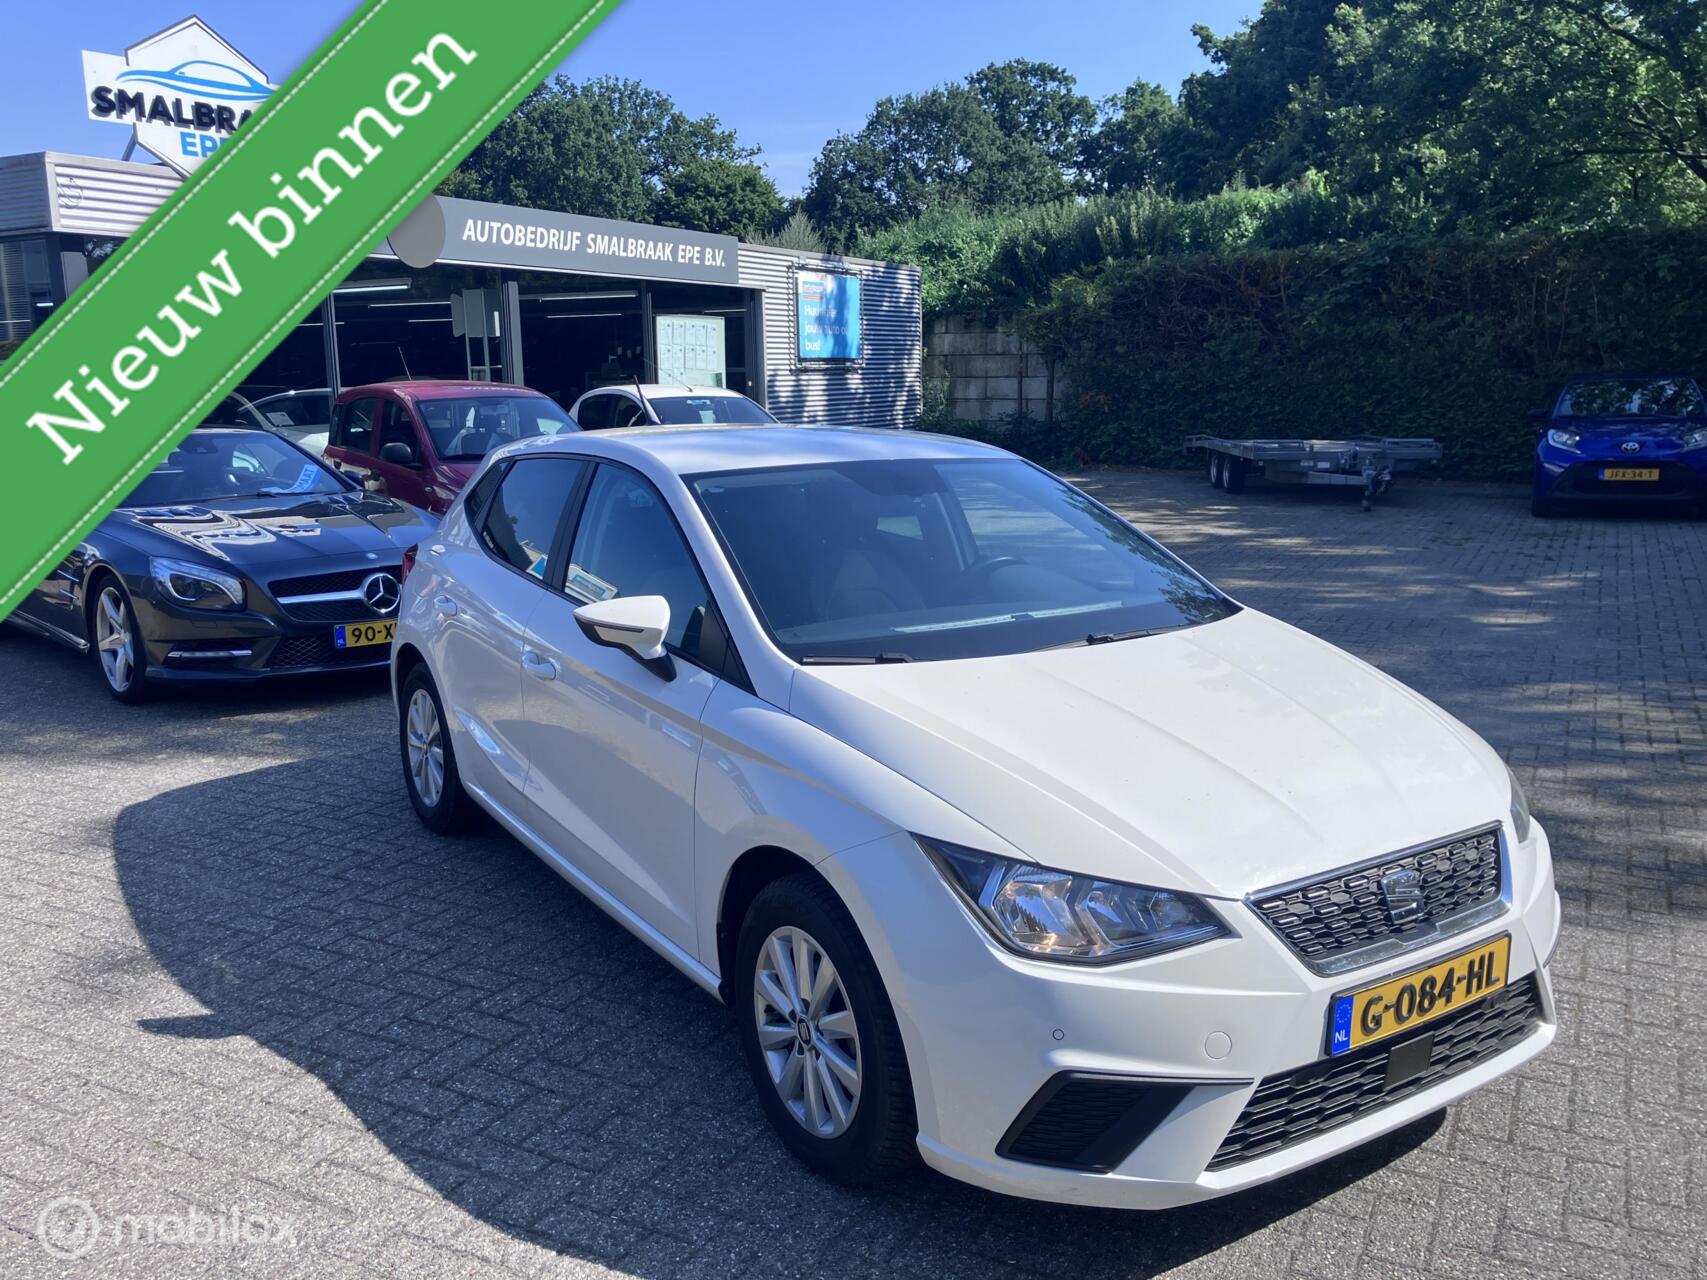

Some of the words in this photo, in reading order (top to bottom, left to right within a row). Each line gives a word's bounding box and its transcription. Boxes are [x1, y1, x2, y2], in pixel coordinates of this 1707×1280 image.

[180, 130, 231, 159] EP
[462, 218, 582, 252] AUTOBEDRIJF
[586, 232, 674, 262] SMALBRAAK
[677, 243, 702, 266] EPE
[704, 246, 727, 268] B.V.
[351, 622, 397, 643] 90-X
[1334, 1029, 1349, 1044] NL
[1360, 951, 1501, 1037] G-084-HL
